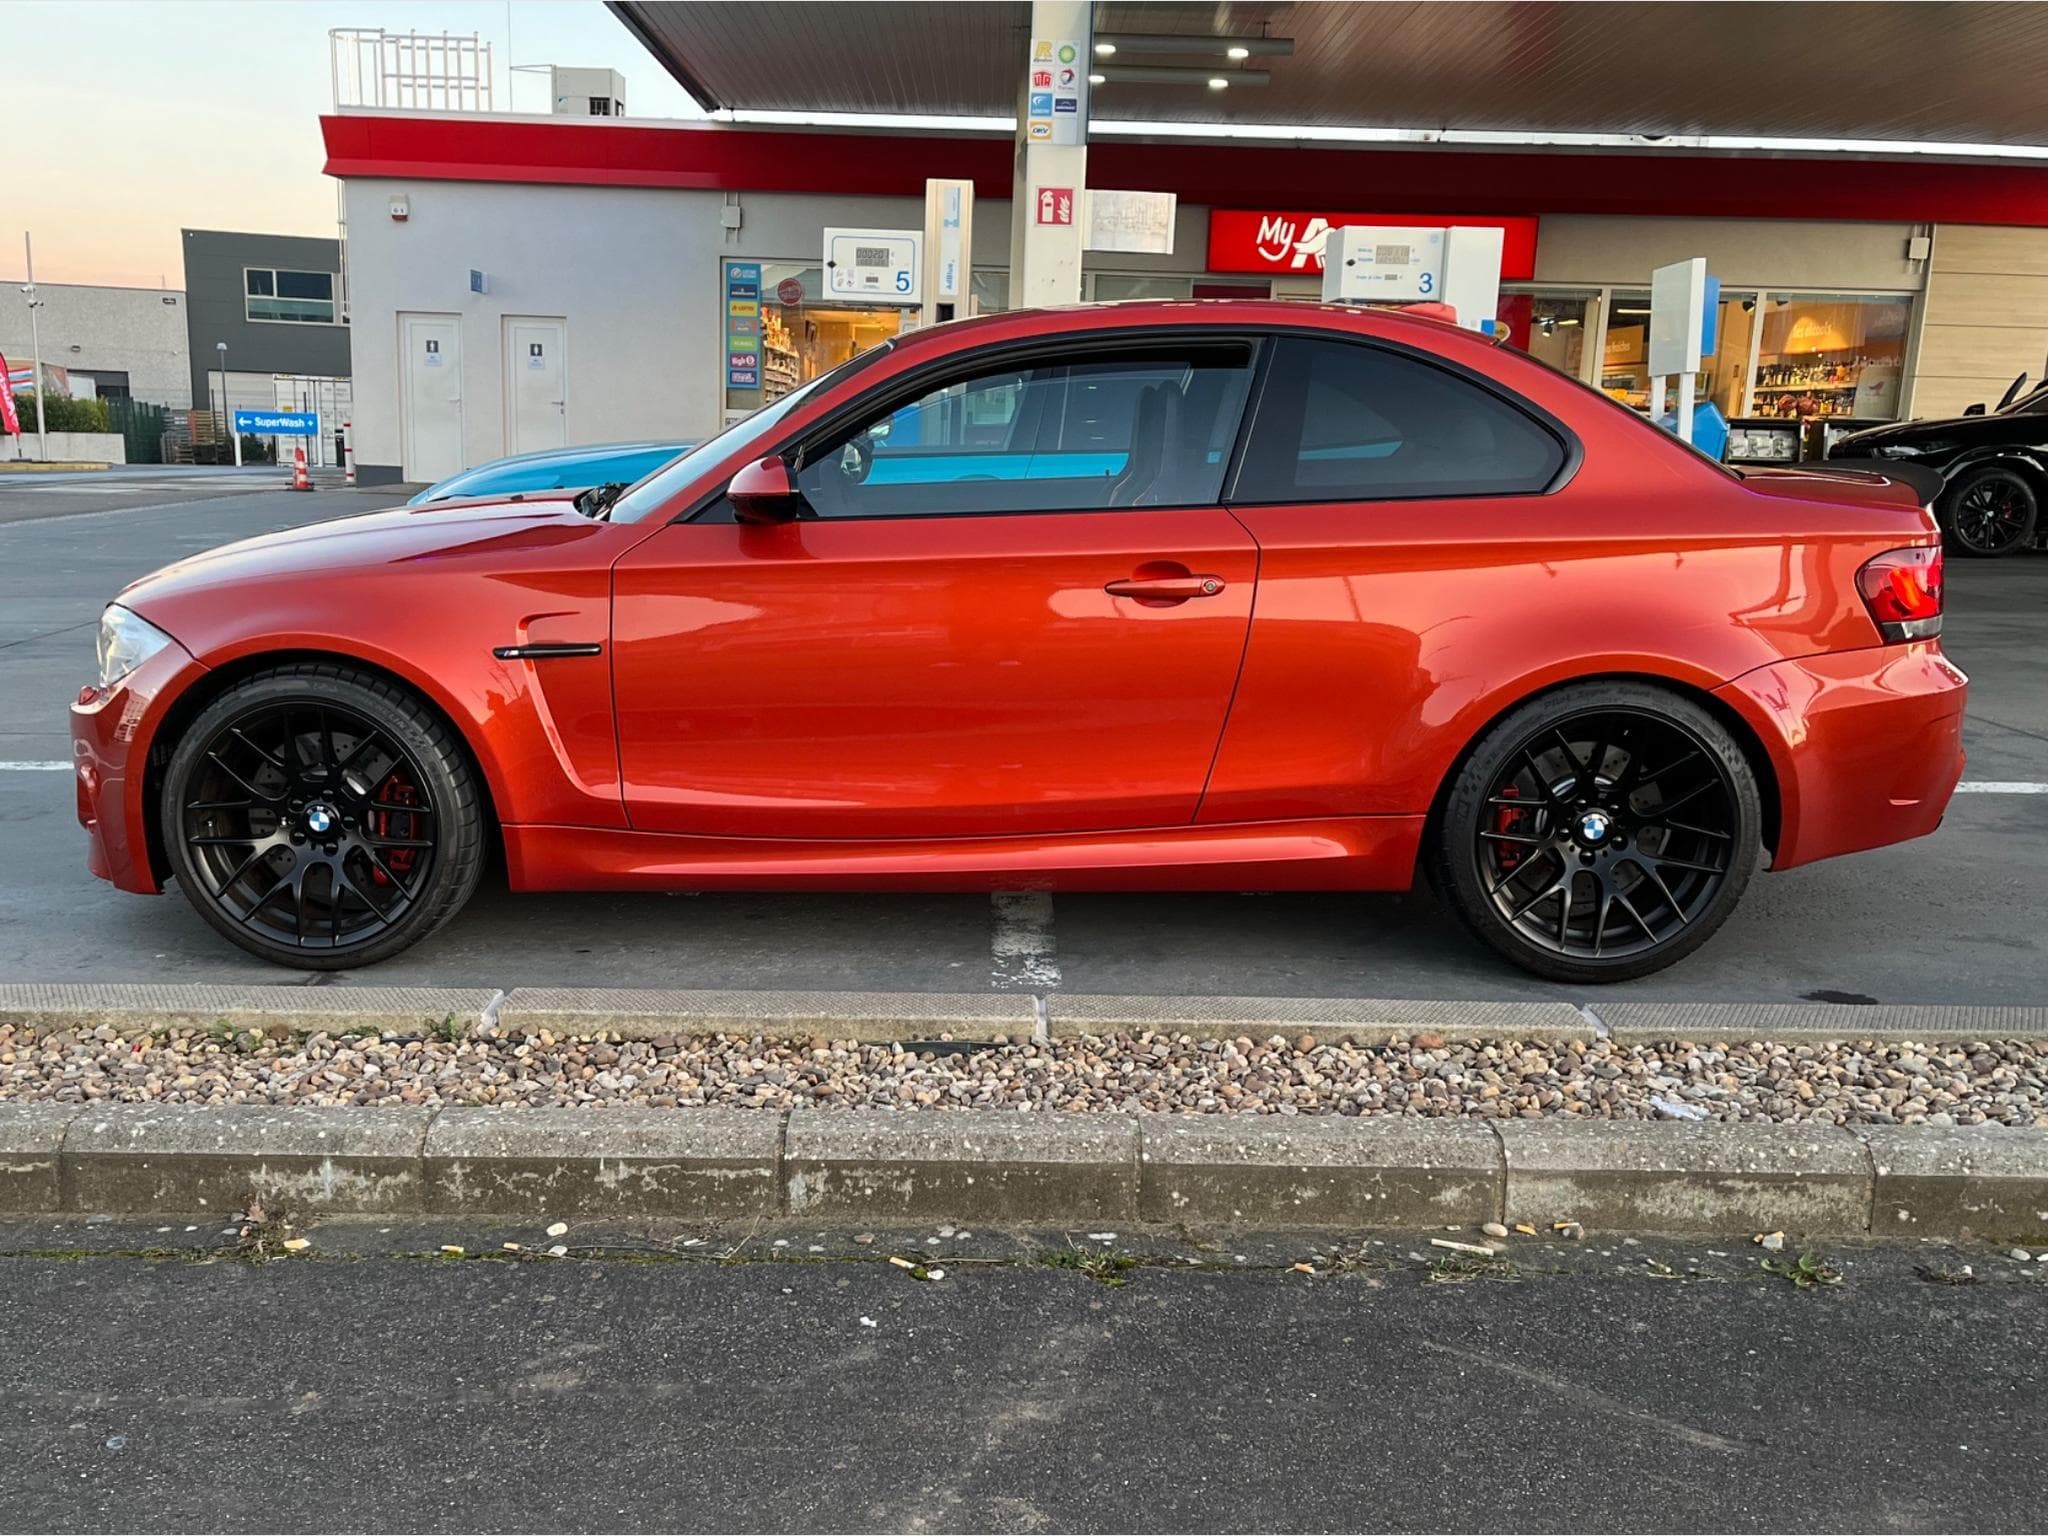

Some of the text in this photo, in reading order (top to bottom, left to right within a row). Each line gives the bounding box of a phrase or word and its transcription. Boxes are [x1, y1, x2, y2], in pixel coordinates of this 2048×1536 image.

[1256, 215, 1296, 262] My
[896, 271, 910, 292] 5
[1418, 272, 1433, 294] 3
[254, 417, 305, 428] SuperWash
